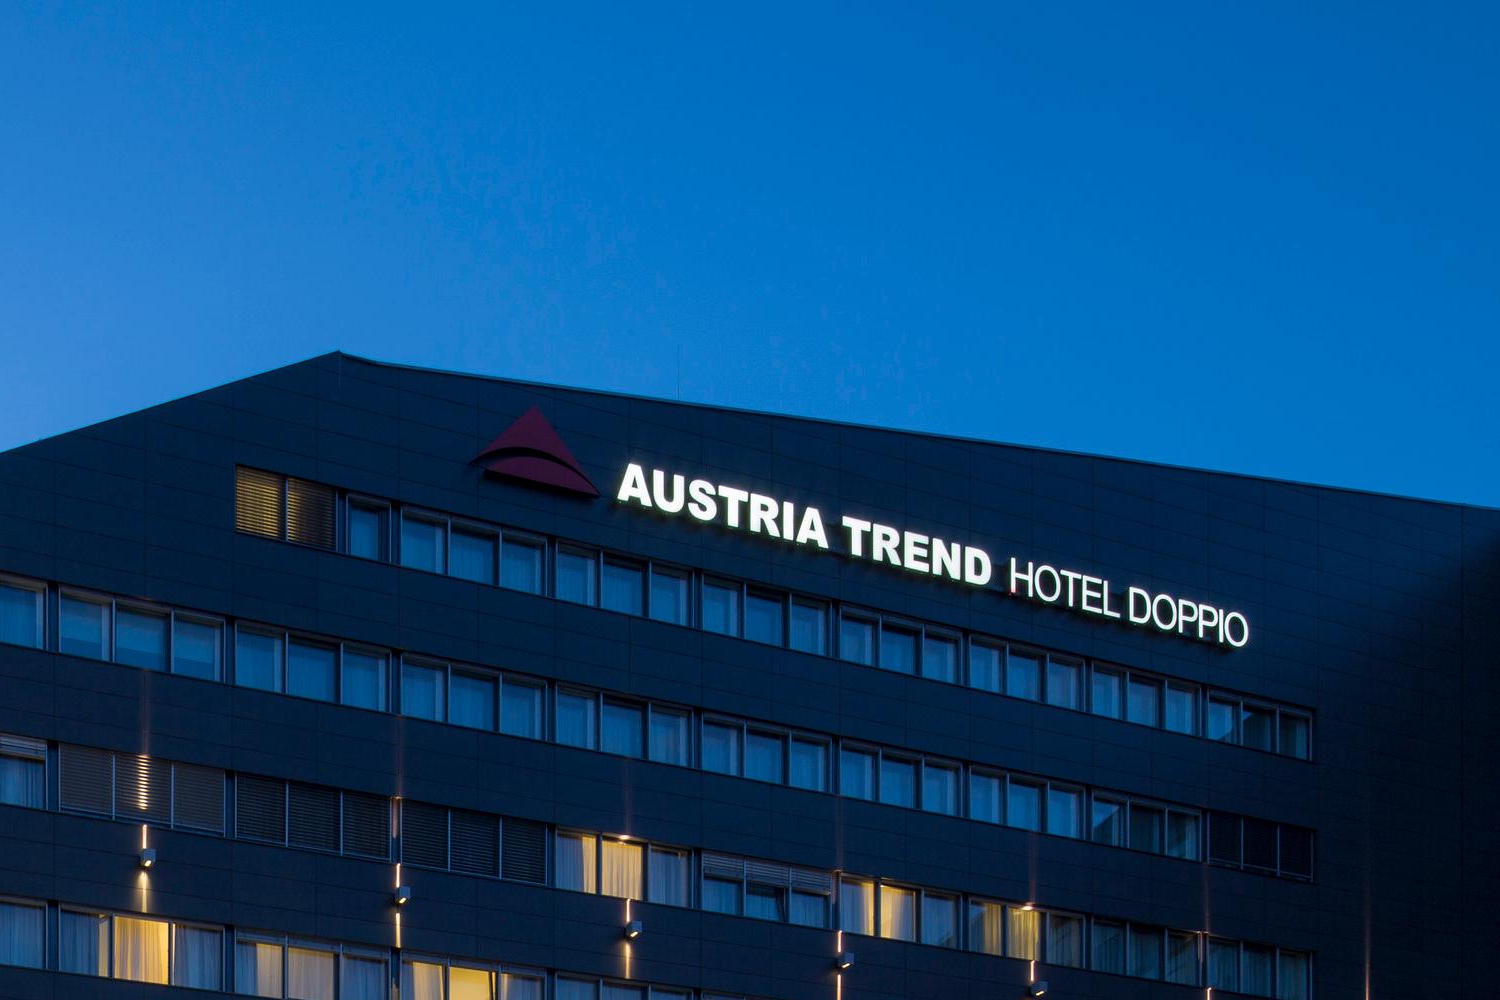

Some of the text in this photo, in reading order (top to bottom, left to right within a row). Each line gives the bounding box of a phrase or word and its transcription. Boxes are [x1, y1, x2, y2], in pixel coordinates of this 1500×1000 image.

[617, 463, 1249, 648] AUSTRIA TREND HOTEL DOPPIO
